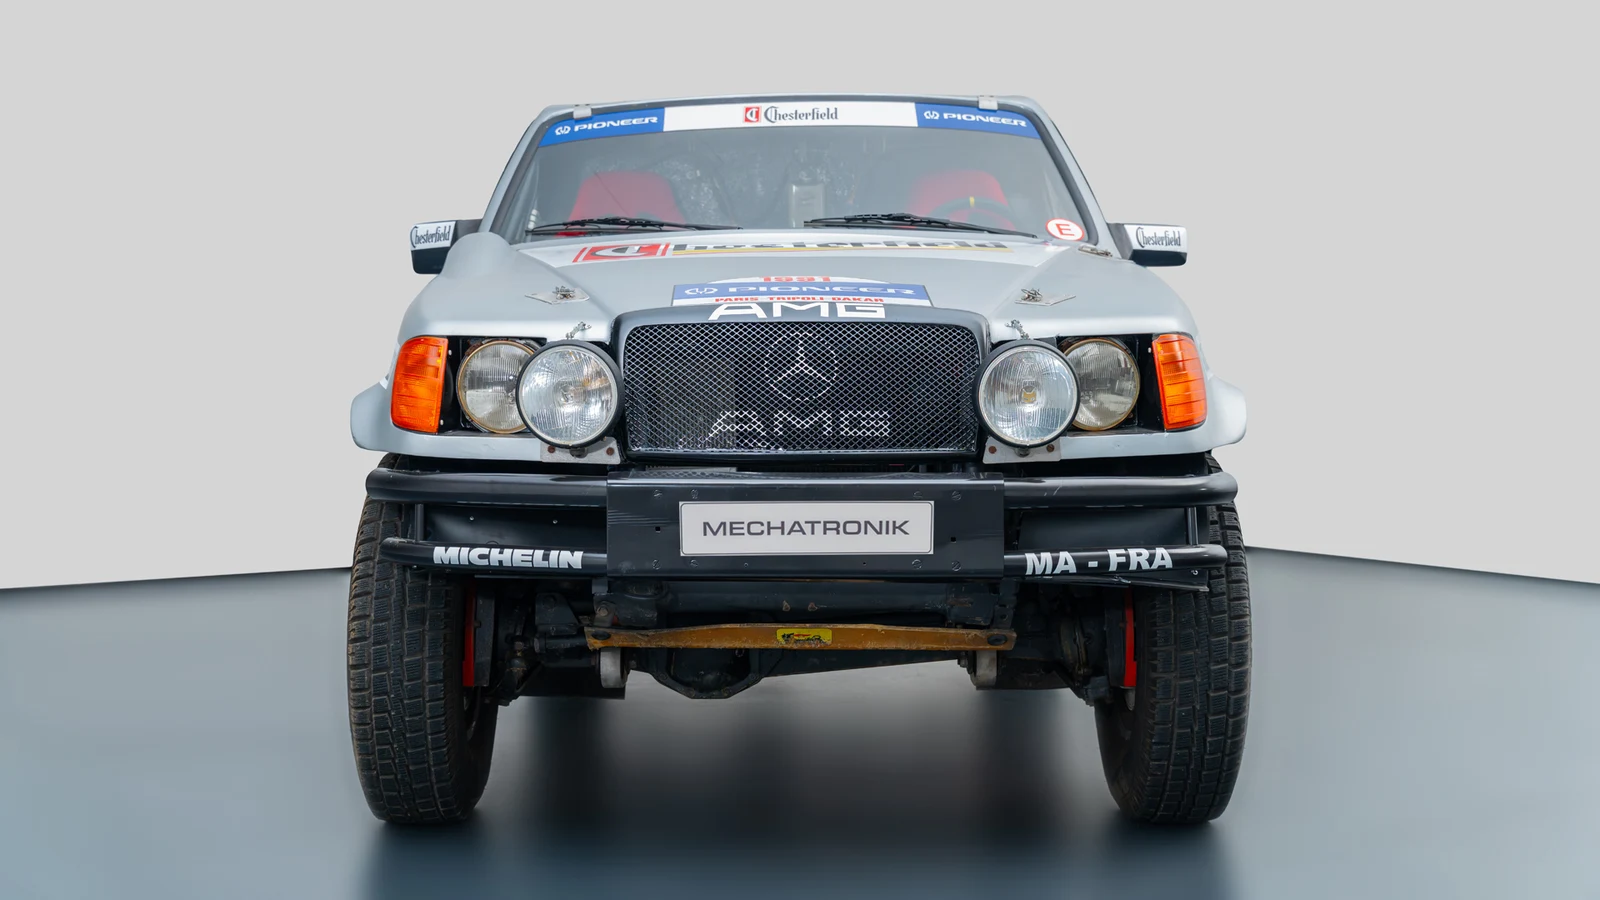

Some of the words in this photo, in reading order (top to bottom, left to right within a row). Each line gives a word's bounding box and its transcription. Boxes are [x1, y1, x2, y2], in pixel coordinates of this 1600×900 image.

[574, 116, 658, 132] PIONEER
[764, 106, 839, 124] Chesterfield
[943, 112, 1027, 127] PIONEER
[410, 225, 451, 249] Chesterfield
[1055, 223, 1075, 236] E
[1136, 226, 1182, 248] Chesterfield
[763, 275, 831, 283] 1991
[728, 286, 916, 295] PIONEER
[708, 302, 886, 320] AMG
[706, 410, 890, 440] AMG
[702, 519, 910, 537] MECHATRONIK
[433, 546, 584, 569] MICHELIN
[1025, 551, 1077, 576] MA
[1107, 547, 1173, 572] FRA
